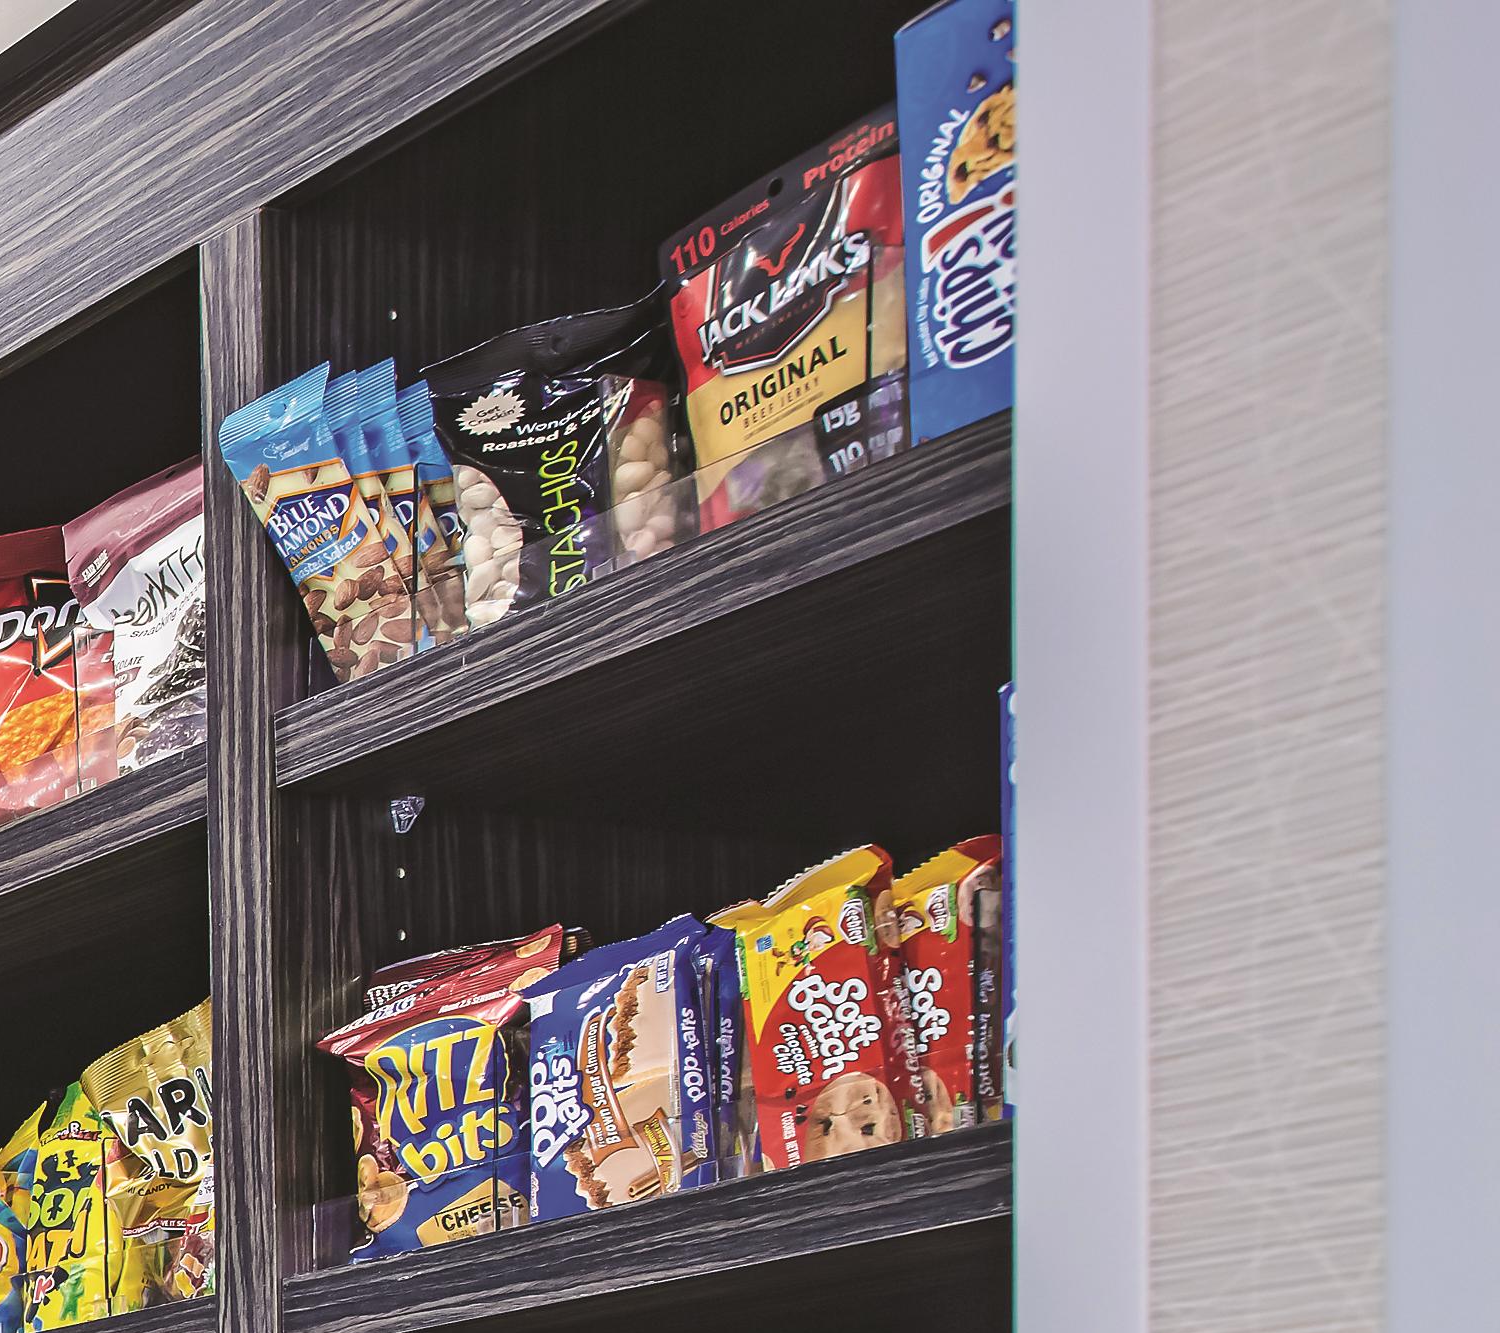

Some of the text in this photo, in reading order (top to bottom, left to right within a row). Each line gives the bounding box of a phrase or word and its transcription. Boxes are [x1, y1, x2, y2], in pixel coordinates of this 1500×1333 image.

[803, 120, 895, 191] Protein
[670, 226, 716, 275] 110
[698, 290, 769, 362] JACK
[719, 335, 848, 427] ORIGINAL
[742, 376, 821, 429] BEEF JERKY
[482, 422, 579, 453] Roasted &
[268, 494, 321, 539] BLUE
[847, 898, 867, 943] Keebler
[787, 975, 858, 1080] Batch
[825, 978, 882, 1051] Soft
[364, 1024, 498, 1151] RITZ
[586, 1022, 622, 1146] Brown Sugar Cinnamon
[772, 1043, 794, 1073] Chip
[778, 1023, 815, 1086] Chocolate
[401, 1105, 513, 1186] bits
